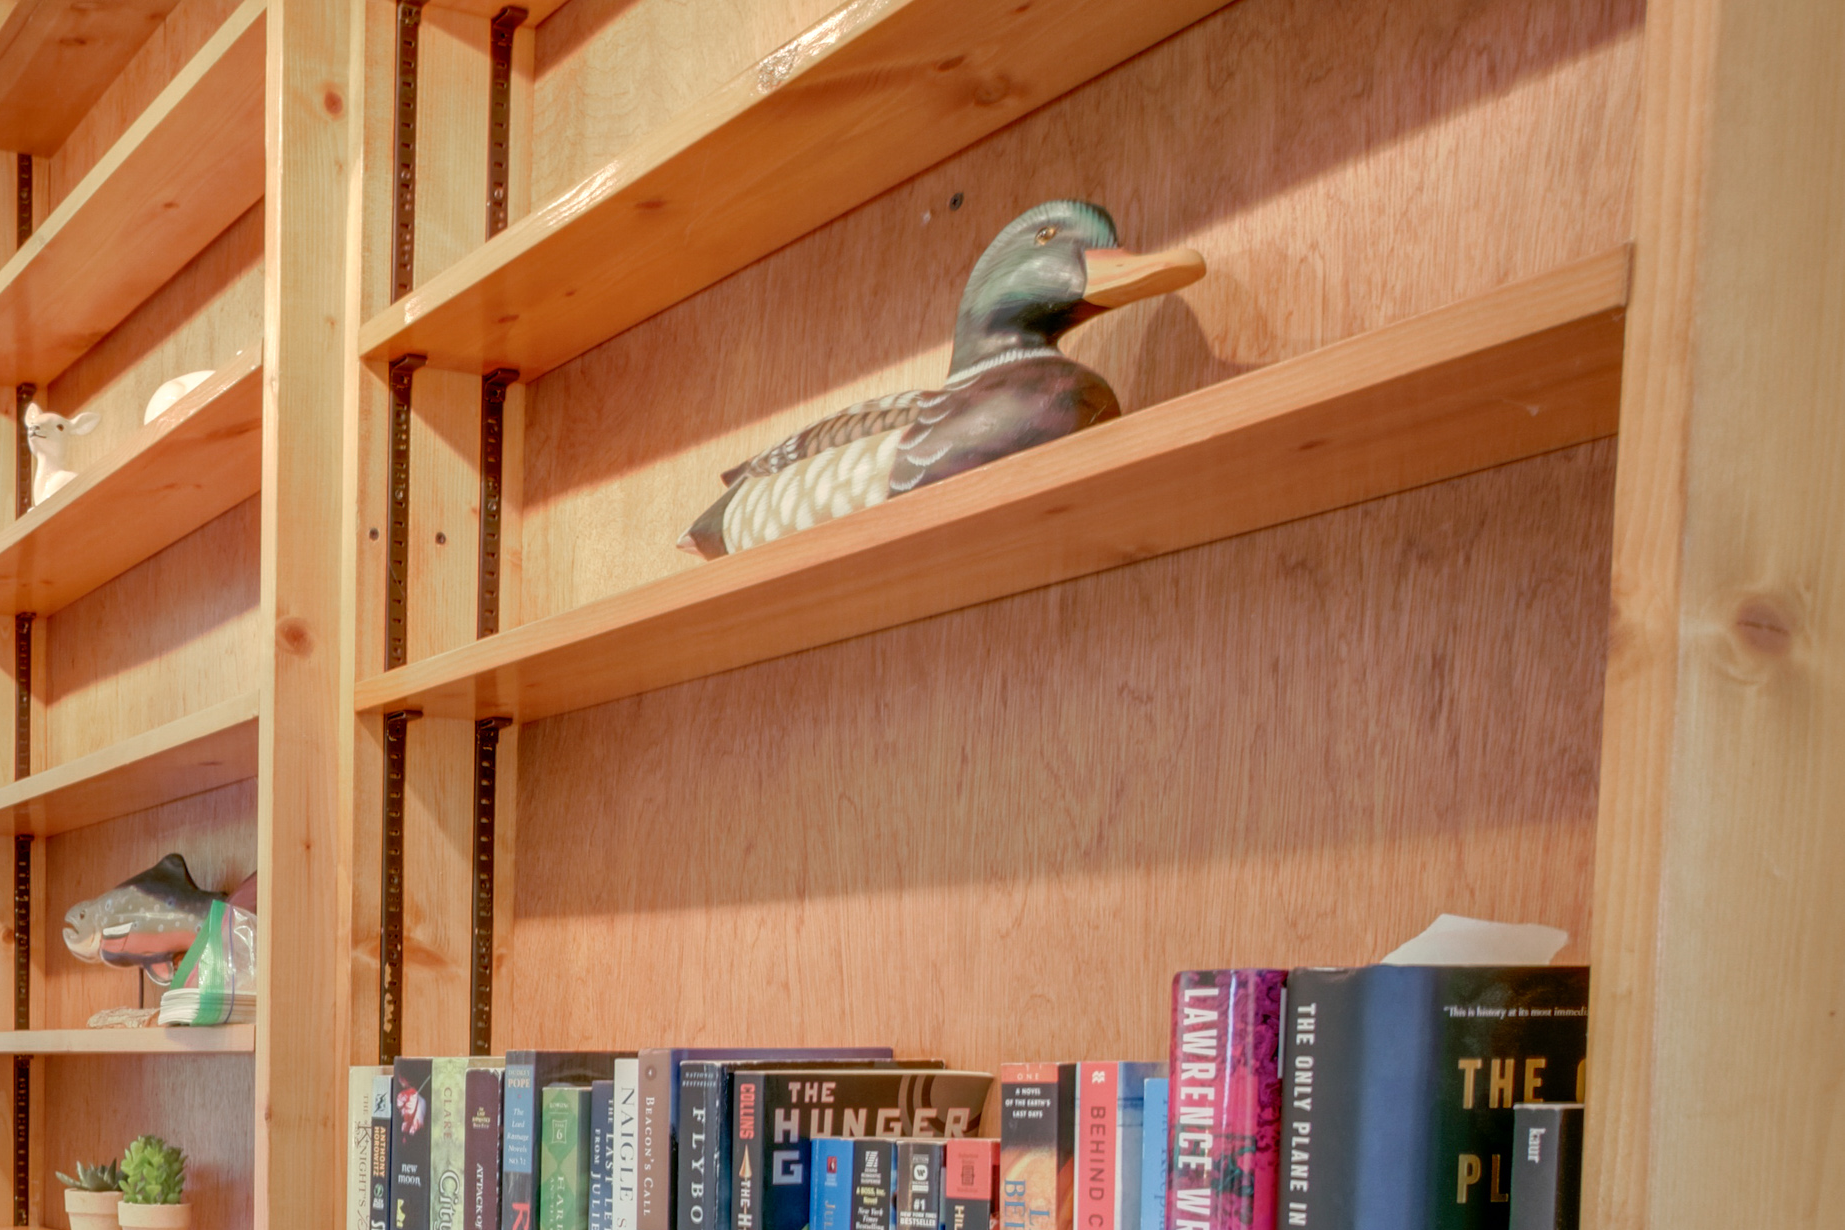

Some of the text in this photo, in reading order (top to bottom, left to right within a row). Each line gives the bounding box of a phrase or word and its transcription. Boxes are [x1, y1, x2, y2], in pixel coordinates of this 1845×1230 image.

[1296, 1003, 1316, 1046] THE
[1468, 1007, 1475, 1017] is
[1476, 1006, 1507, 1020] history
[1507, 1008, 1517, 1017] at
[1518, 1007, 1529, 1017] its
[1530, 1008, 1552, 1017] most
[507, 1078, 531, 1089] POPE
[1016, 1072, 1041, 1081] ONE
[1178, 987, 1219, 1171] LAWRENCE
[1293, 1055, 1315, 1112] ONLY
[1458, 1058, 1546, 1110] THE
[788, 1081, 837, 1103] THE
[1005, 1098, 1014, 1107] OF
[1015, 1098, 1026, 1107] THE
[1015, 1087, 1041, 1096] A NOVEL
[443, 1087, 452, 1139] CLARE
[513, 1107, 525, 1117] The
[739, 1083, 755, 1140] COLLINS
[774, 1107, 972, 1144] HUNGER
[1012, 1110, 1043, 1119] LAST DAYS
[506, 1132, 530, 1142] Ramage
[556, 1129, 563, 1140] 6
[593, 1128, 601, 1165] FROM
[619, 1087, 635, 1201] NAIGLE
[1527, 1127, 1546, 1163] kaur
[355, 1119, 371, 1207] KNIGHT'S
[507, 1145, 528, 1154] Novels
[605, 1132, 614, 1187] LAST
[643, 1096, 656, 1216] BEACON'S CALL
[1087, 1106, 1106, 1202] BEHIND
[1289, 1122, 1312, 1193] PLANE
[398, 1174, 421, 1186] moon
[402, 1163, 418, 1172] new
[476, 1163, 484, 1214] ATTACK
[740, 1180, 751, 1208] THE
[914, 1198, 925, 1211] #1
[1287, 1203, 1307, 1227] IN
[900, 1217, 936, 1227] BESTSELLER
